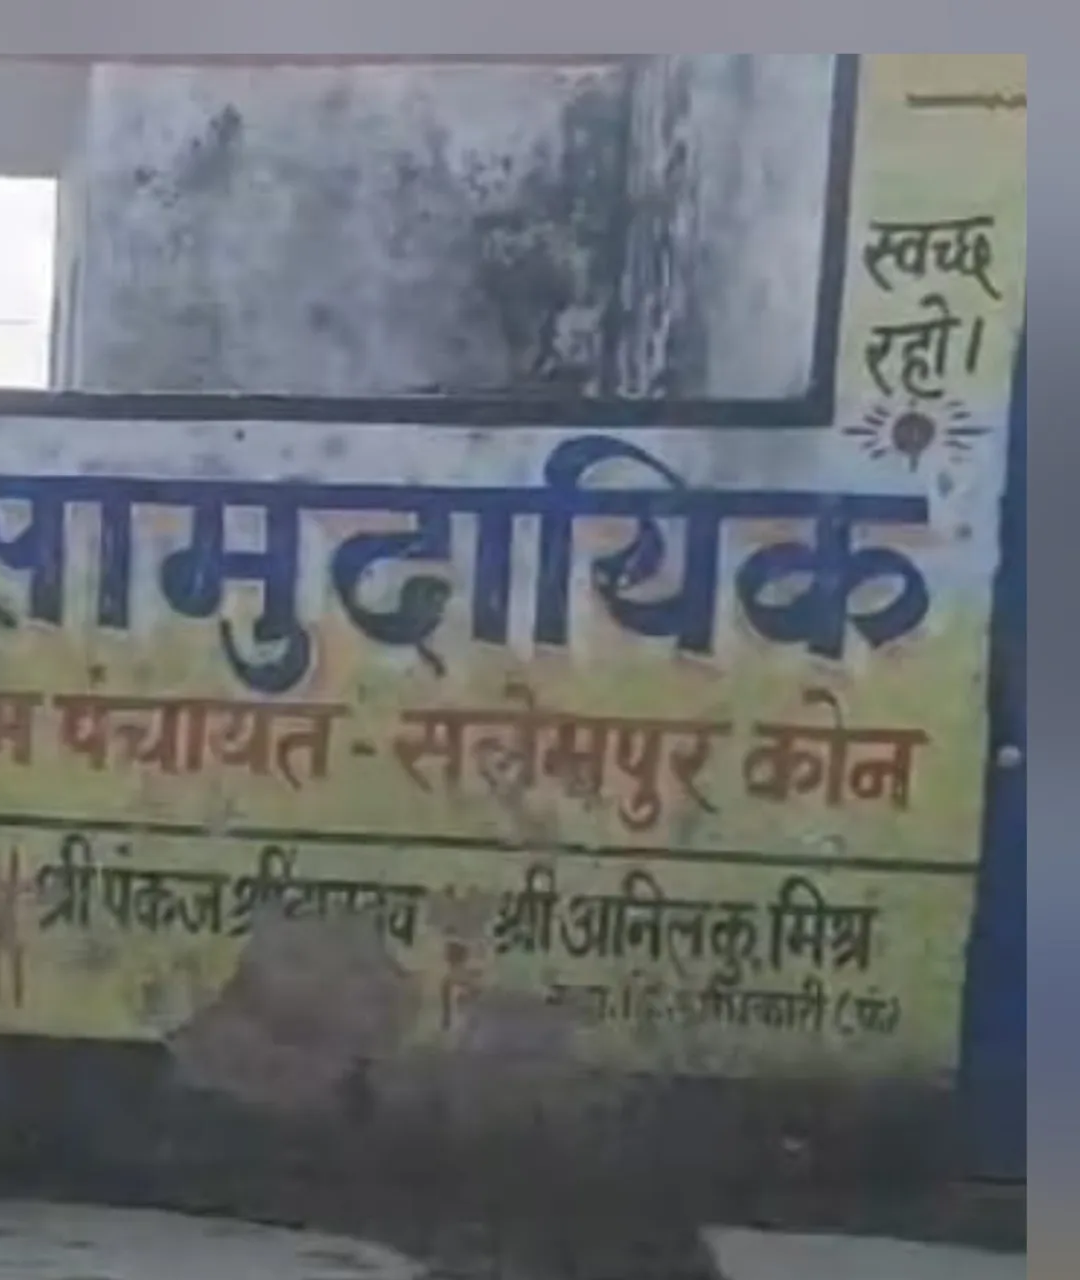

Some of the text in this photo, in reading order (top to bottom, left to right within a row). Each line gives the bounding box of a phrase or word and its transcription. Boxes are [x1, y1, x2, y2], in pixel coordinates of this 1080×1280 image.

[864, 216, 1002, 300] स्वच्छ
[393, 683, 732, 829] सलेमपुर
[743, 688, 930, 812] कोन
[100, 842, 230, 936] पंकज
